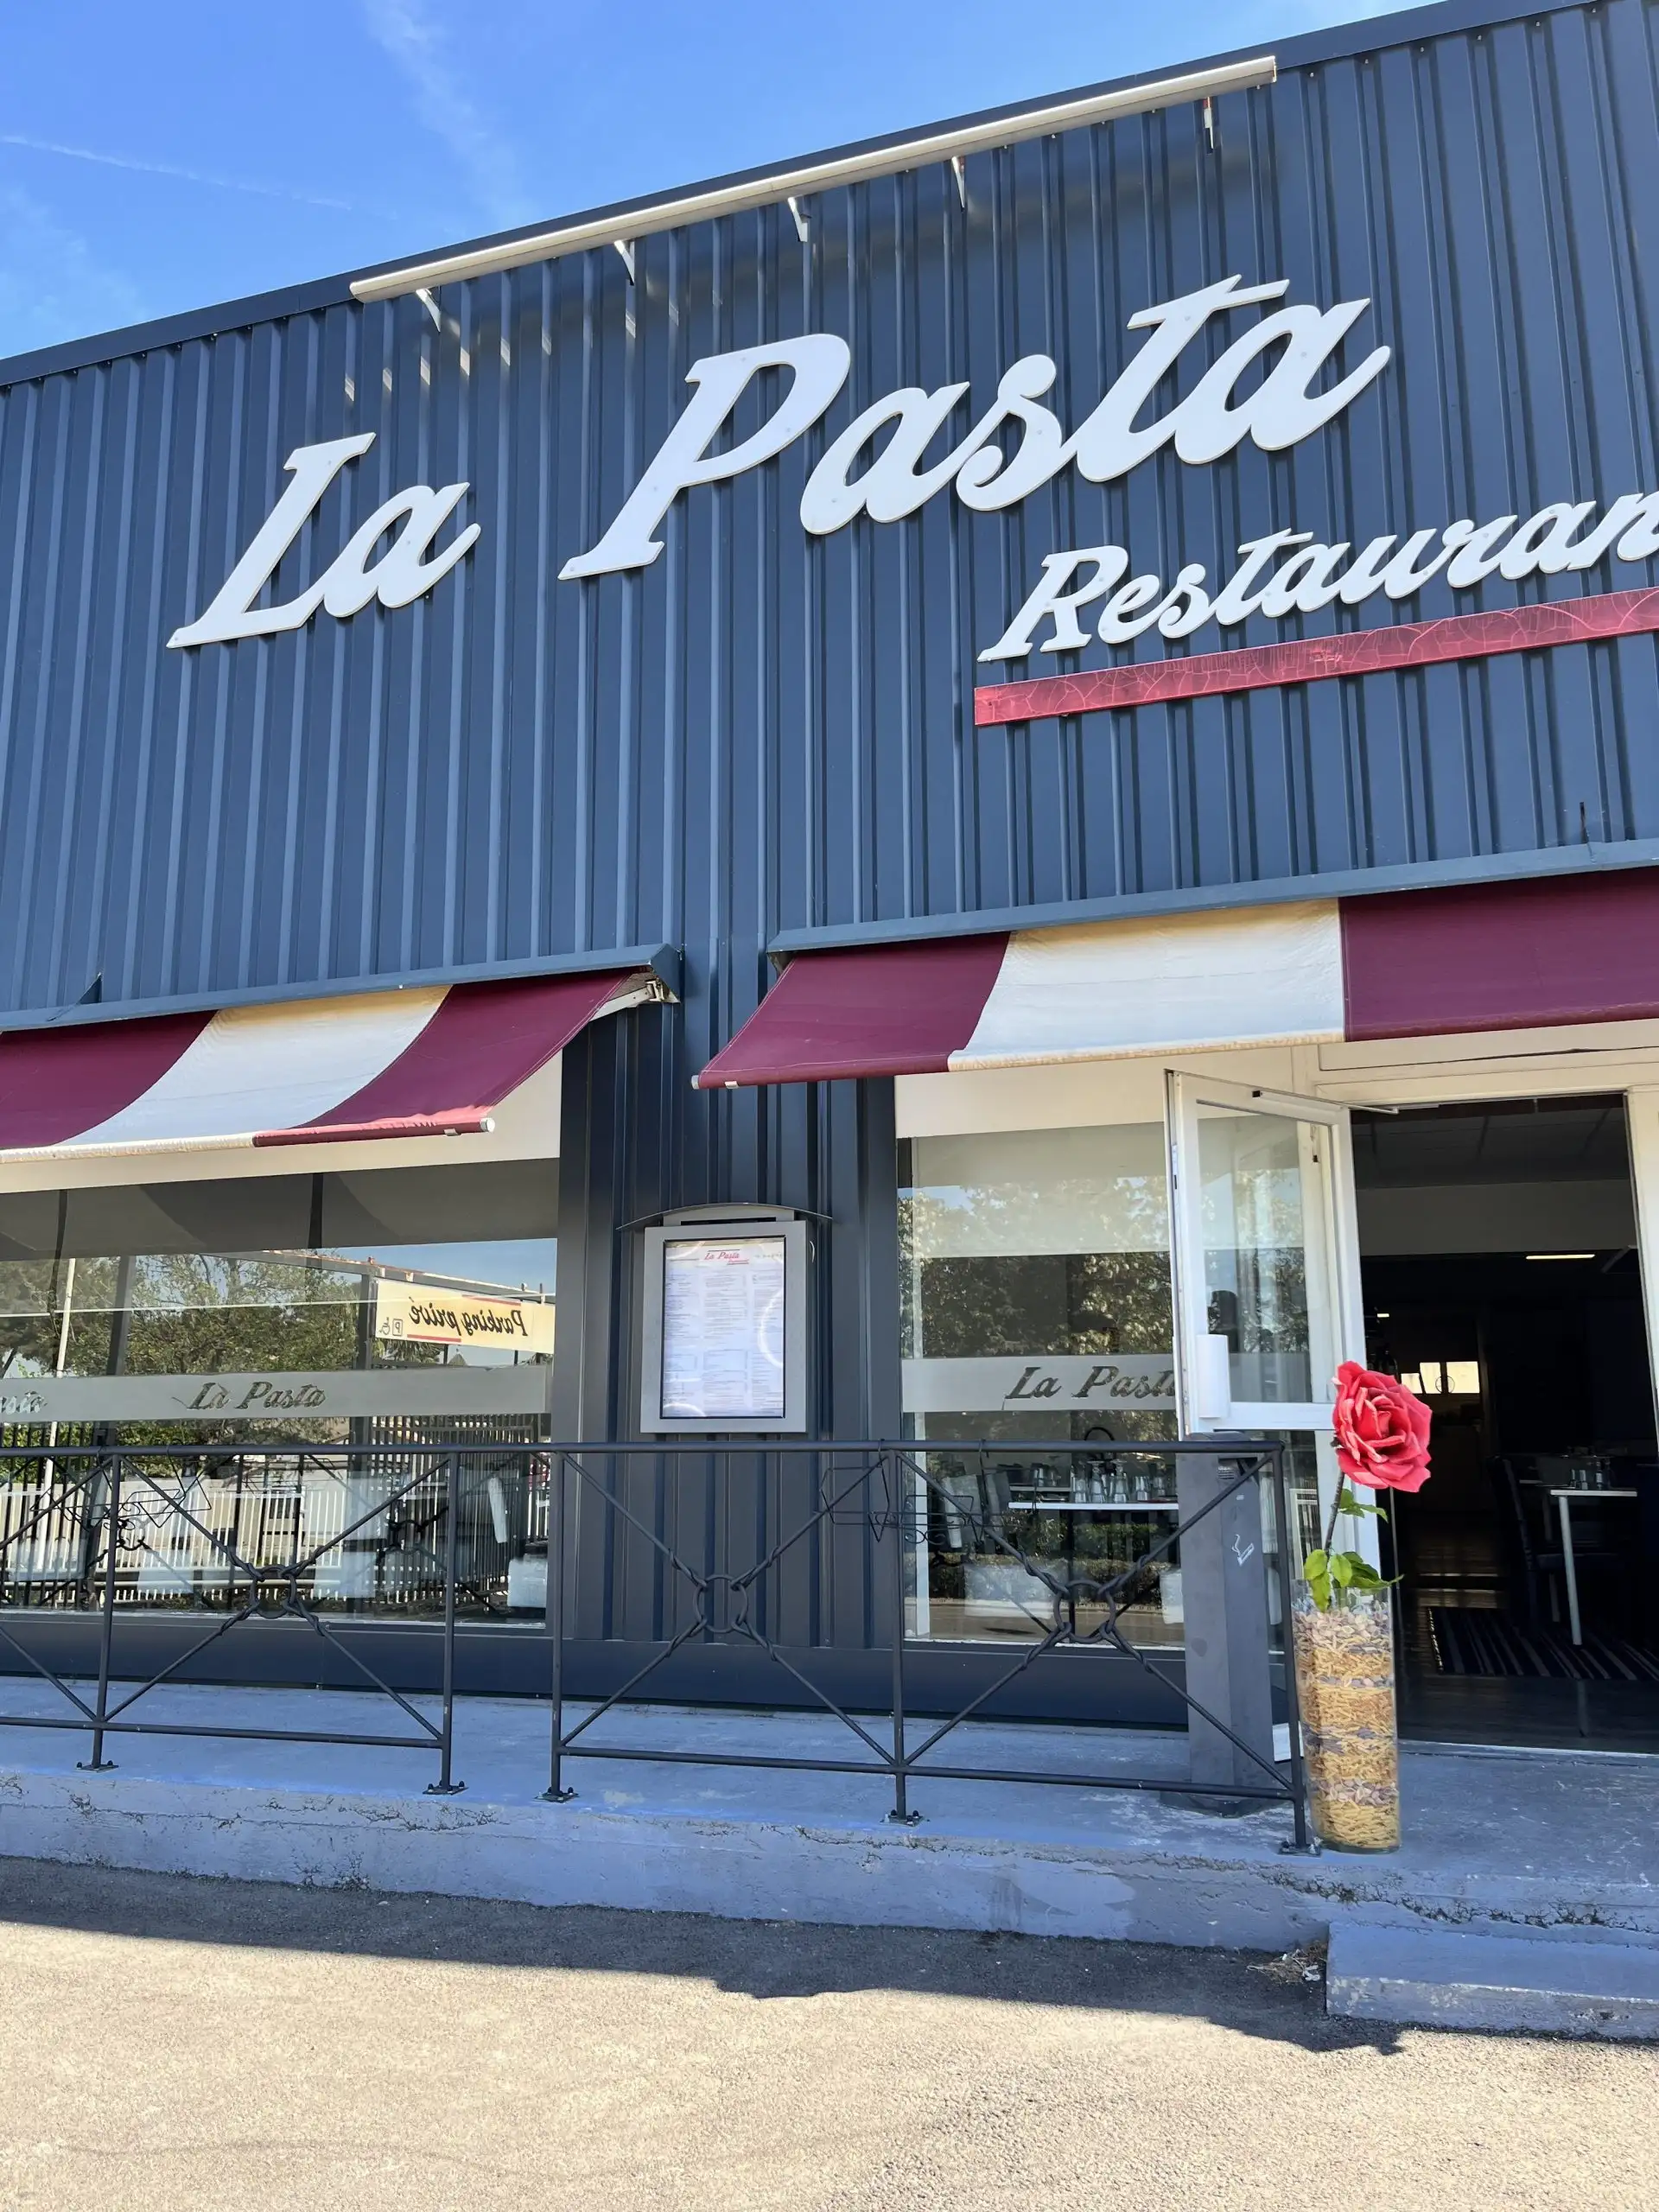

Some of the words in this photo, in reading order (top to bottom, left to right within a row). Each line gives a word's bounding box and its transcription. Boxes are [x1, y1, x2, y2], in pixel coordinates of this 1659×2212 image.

[167, 432, 482, 650] La
[557, 274, 1393, 582] Pasta
[186, 1382, 232, 1410] La
[234, 1381, 326, 1409] Pasta
[1004, 1366, 1062, 1399] La
[1071, 1365, 1176, 1399] Past
